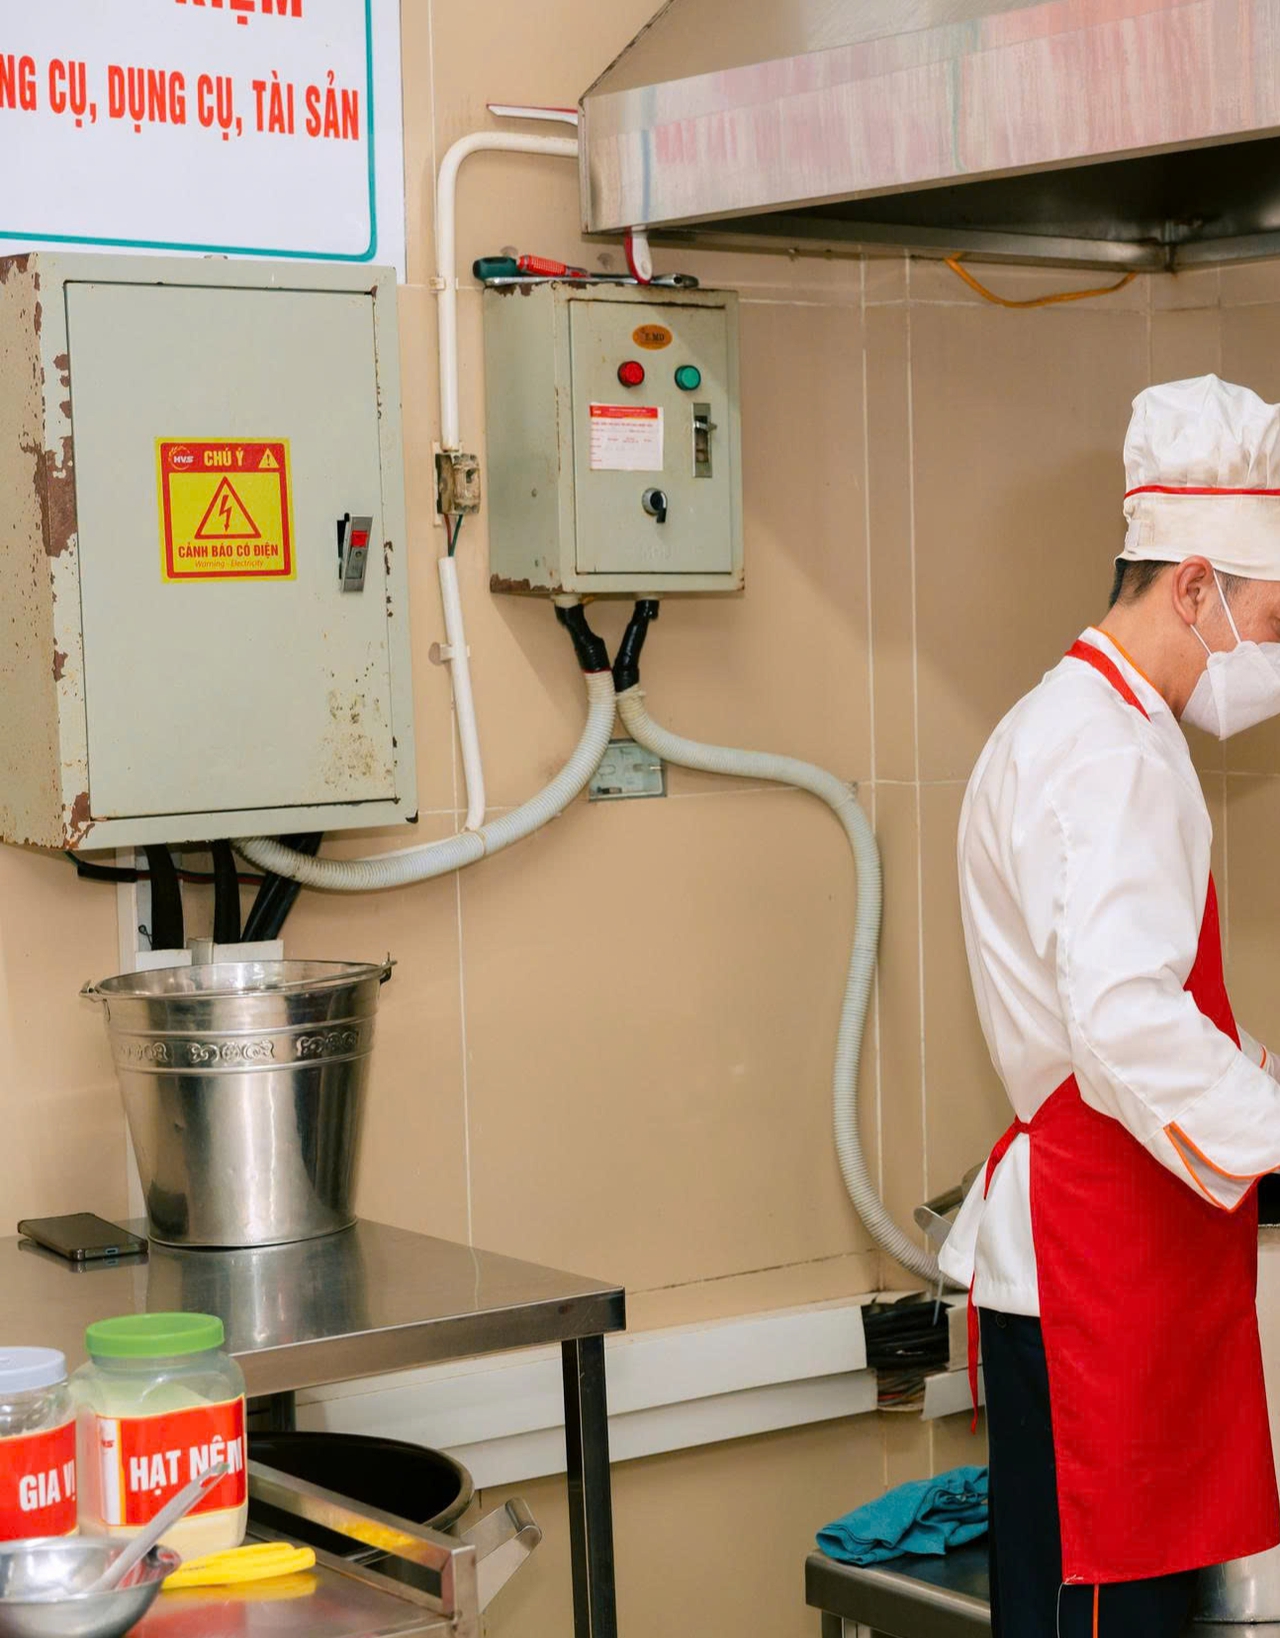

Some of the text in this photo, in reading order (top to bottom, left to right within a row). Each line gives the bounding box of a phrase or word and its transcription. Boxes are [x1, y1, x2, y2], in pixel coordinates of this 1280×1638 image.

[48, 58, 97, 128] CỤ,
[107, 65, 187, 134] DỤNG
[197, 73, 242, 141] CỤ,
[252, 69, 295, 135] TÀI
[305, 69, 360, 141] SẢN
[204, 447, 244, 467] CHÚ Ý
[178, 541, 279, 559] CẢNH BÁO CÓ ĐIỆN
[19, 1467, 61, 1512] GIA
[129, 1449, 182, 1496] HẠT
